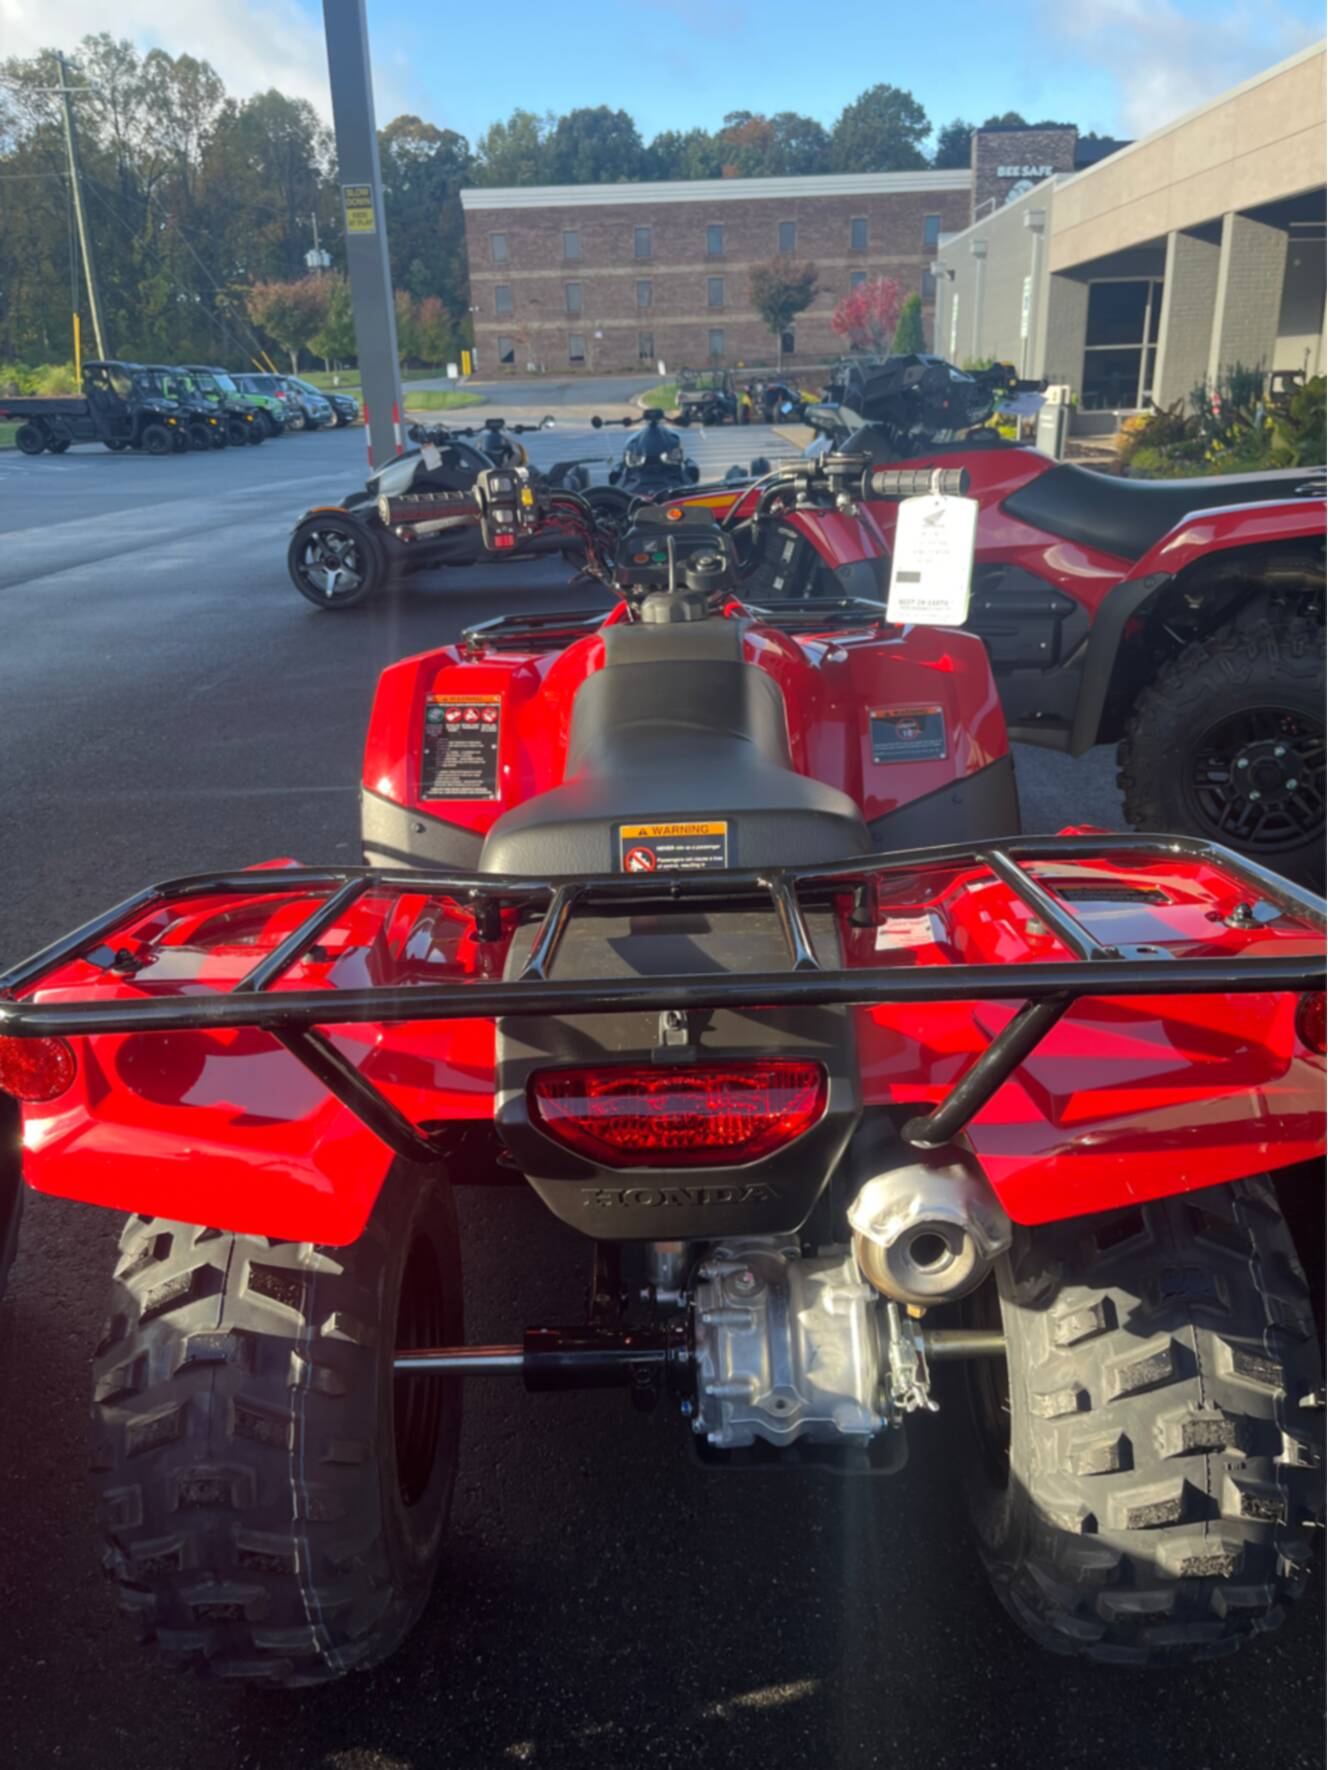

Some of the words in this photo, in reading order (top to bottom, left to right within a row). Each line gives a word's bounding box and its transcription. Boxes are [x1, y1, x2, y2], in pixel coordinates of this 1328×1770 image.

[997, 166, 1020, 177] BEE
[1022, 165, 1053, 176] SAFE
[652, 824, 709, 835] WARNING
[581, 1184, 781, 1207] HONDA
